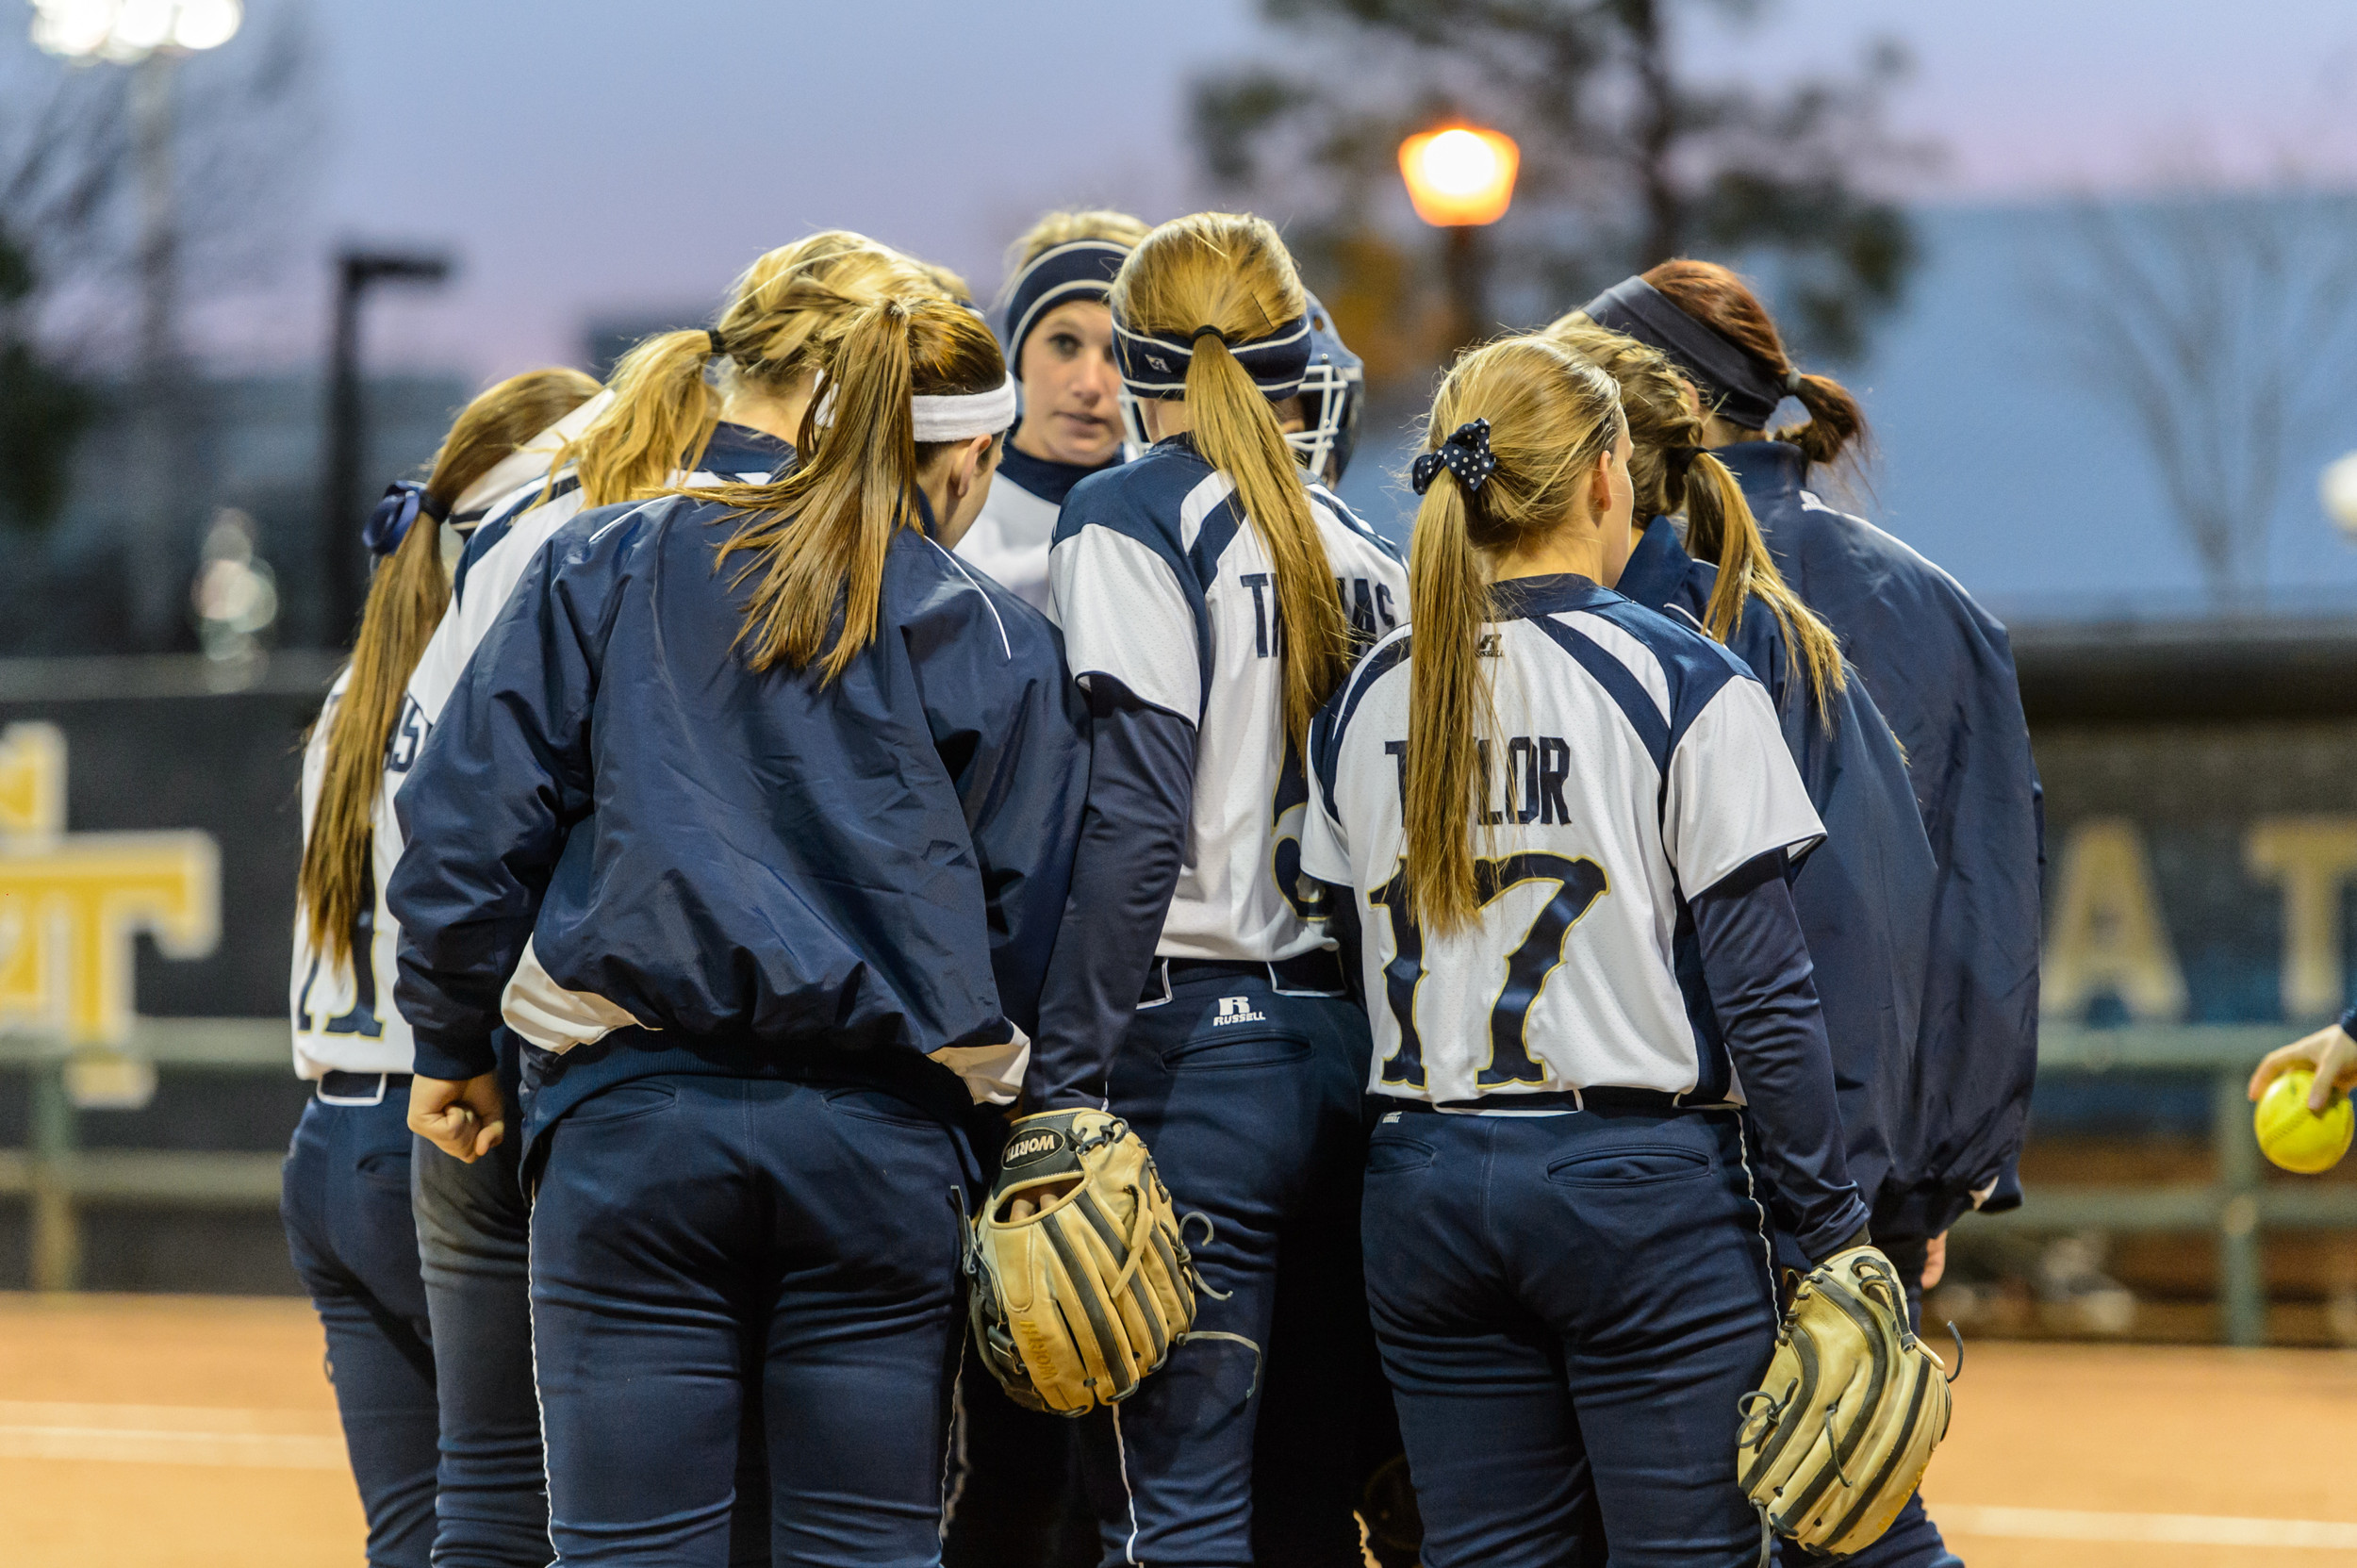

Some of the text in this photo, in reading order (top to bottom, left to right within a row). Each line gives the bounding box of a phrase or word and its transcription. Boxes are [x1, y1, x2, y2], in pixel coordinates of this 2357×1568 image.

[1240, 573, 1395, 658] TAS
[1384, 735, 1573, 827] TLOR
[1367, 850, 1610, 1092] 17
[1212, 1011, 1266, 1026] RUSSELL
[1005, 1134, 1055, 1163] WORTH
